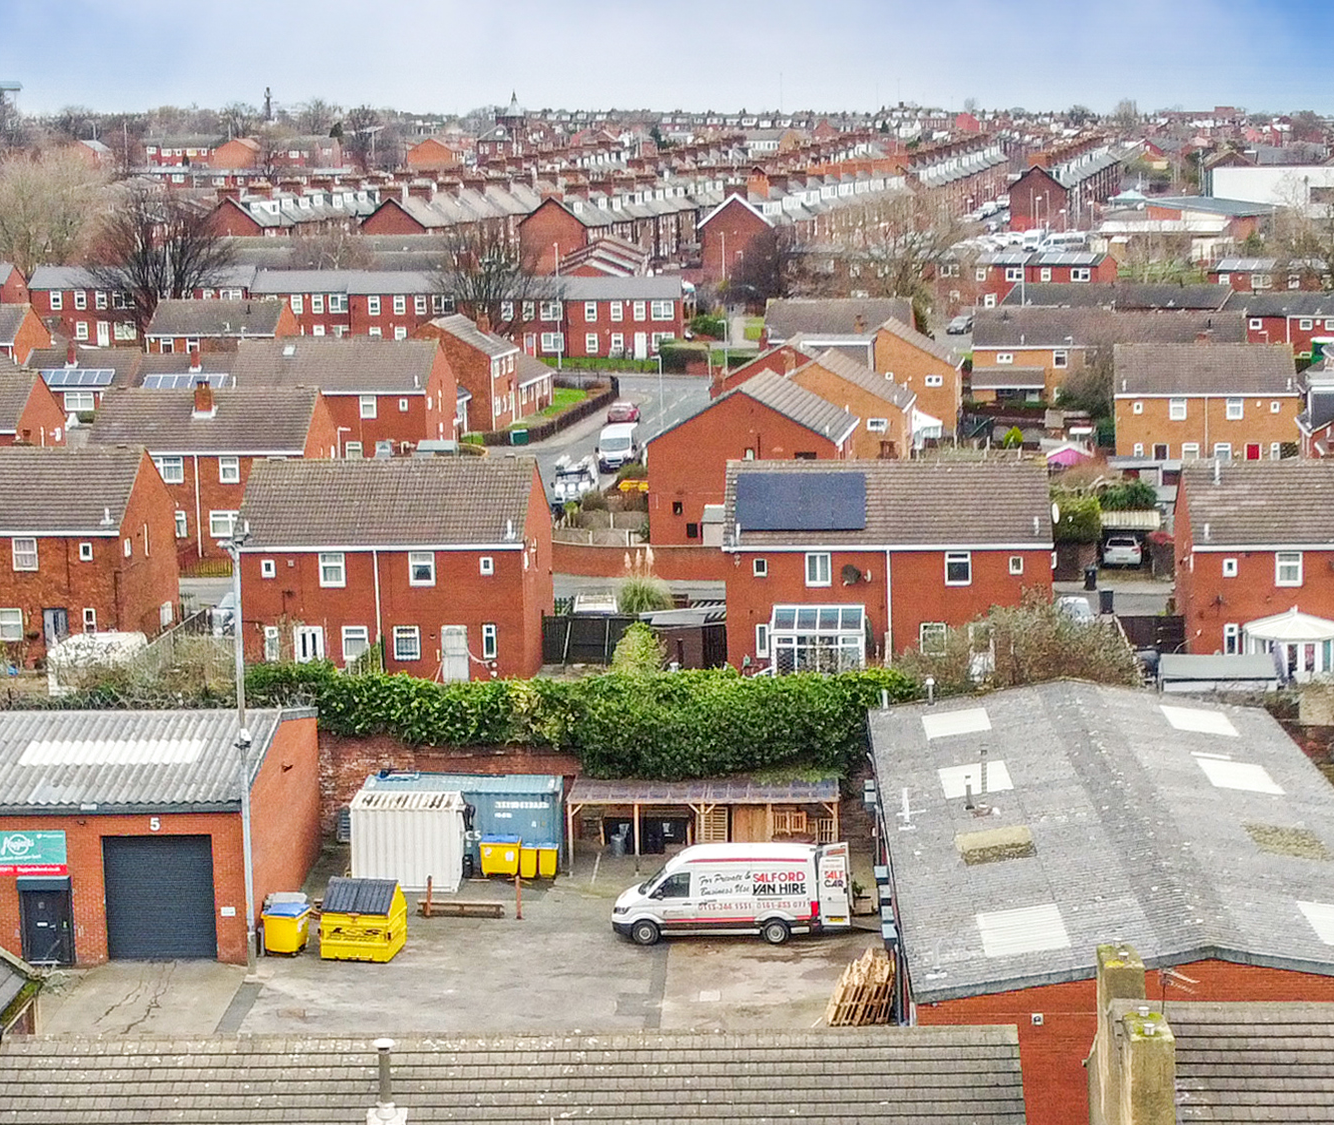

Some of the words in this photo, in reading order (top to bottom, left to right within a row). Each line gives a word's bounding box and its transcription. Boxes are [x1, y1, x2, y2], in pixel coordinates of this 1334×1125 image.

[150, 817, 161, 831] 5
[753, 871, 805, 883] SALFORD
[752, 884, 776, 896] VAN
[779, 883, 807, 894] HIRE
